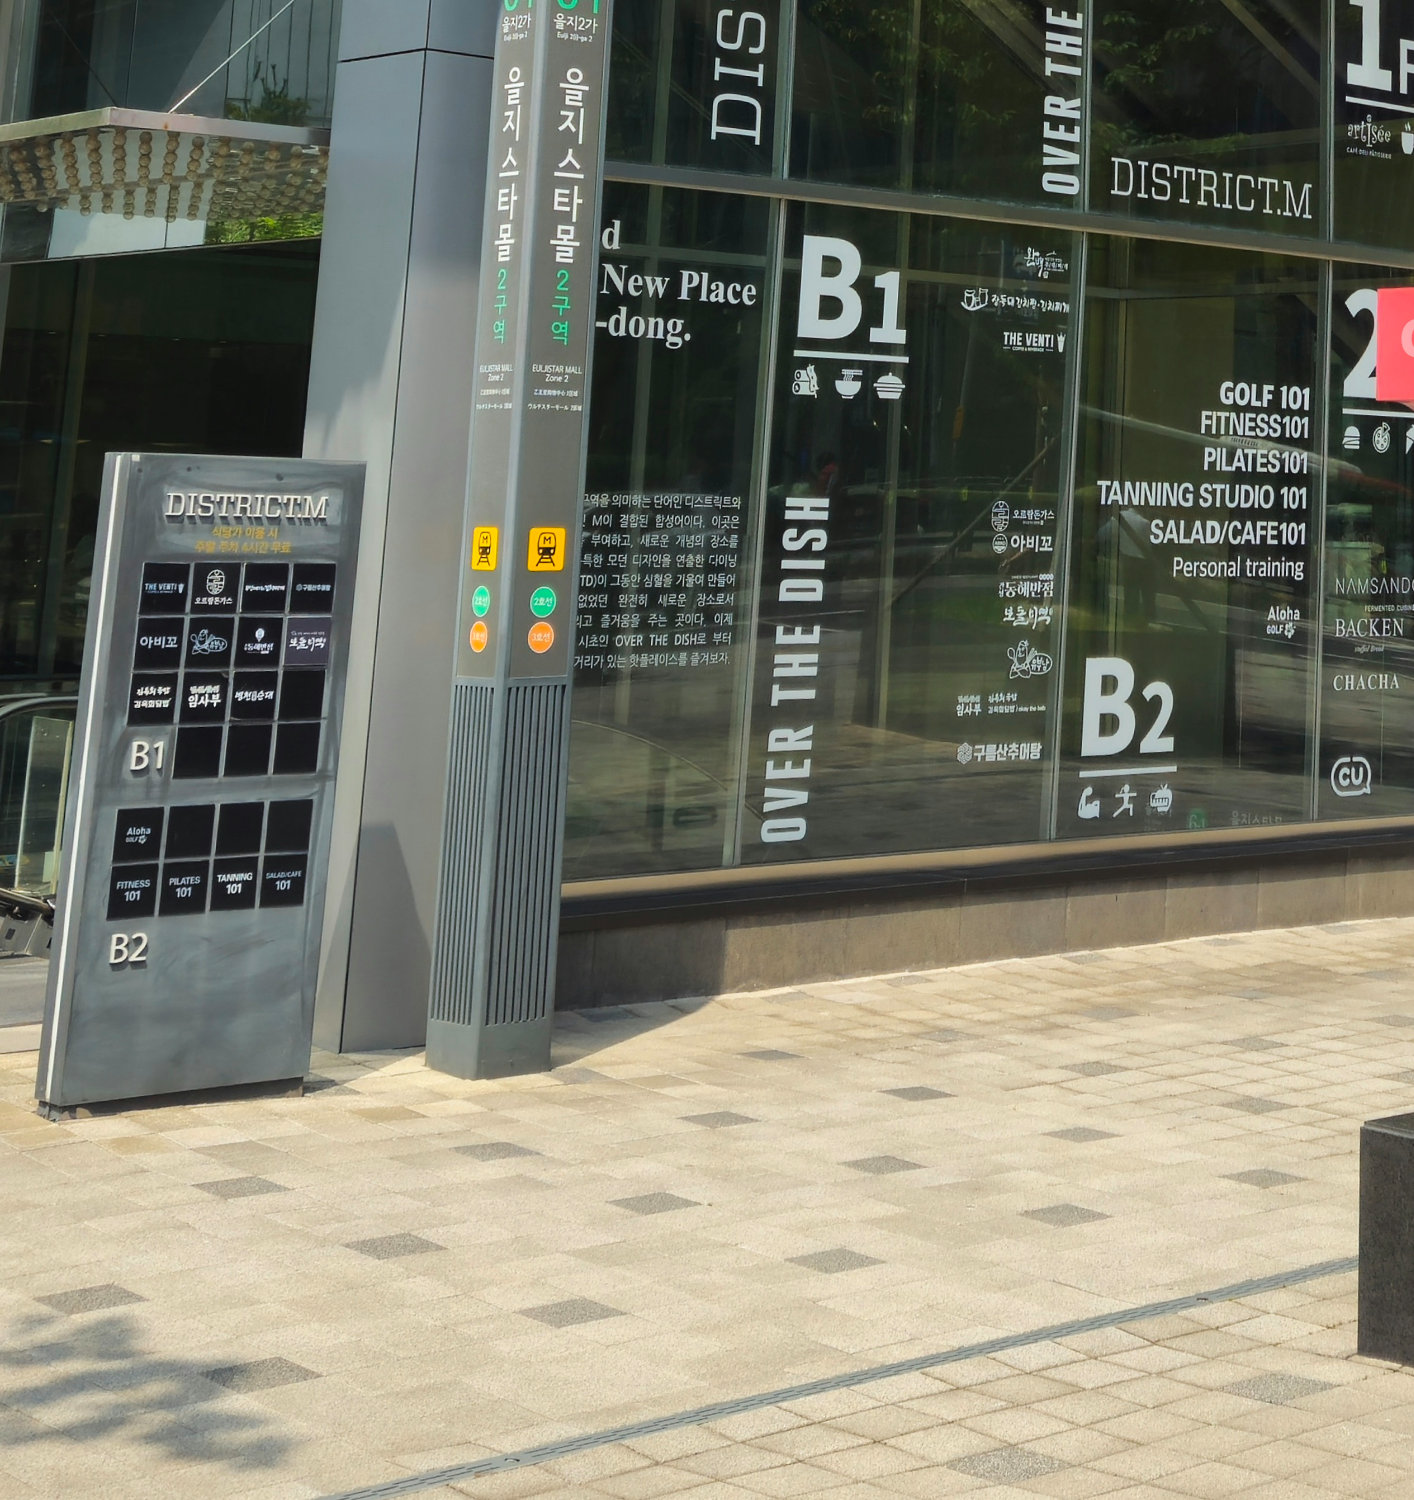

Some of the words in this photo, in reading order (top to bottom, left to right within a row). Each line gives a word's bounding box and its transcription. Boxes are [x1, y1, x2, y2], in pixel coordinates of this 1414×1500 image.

[502, 12, 531, 33] 을지2가
[554, 13, 598, 34] 을지2가
[1046, 6, 1083, 76] THE
[1347, 114, 1391, 147] artisée
[1042, 95, 1081, 194] OVER
[495, 67, 524, 262] 을지스타몰
[550, 67, 589, 263] 을지스타몰
[1111, 156, 1312, 219] DISTRICT.M
[601, 263, 670, 299] New
[677, 270, 757, 306] Place
[798, 234, 907, 345] B1
[493, 269, 508, 344] 2구역
[551, 269, 571, 345] 2구역
[595, 306, 691, 349] -dong.
[1003, 332, 1022, 345] THE
[1026, 333, 1054, 348] VENTI
[501, 364, 513, 372] MALL
[532, 364, 564, 373] EULJISTAR
[565, 365, 582, 374] MALL
[545, 374, 563, 382] Zone
[1220, 381, 1274, 407] GOLF
[1280, 385, 1310, 411] 101
[612, 494, 651, 508] 의미하는
[654, 495, 682, 509] 단어인
[685, 496, 741, 510] 디스트릭트와
[1097, 480, 1193, 507] TANNING
[1199, 483, 1275, 509] STUDIO
[1280, 487, 1307, 509] 101
[165, 493, 328, 519] DISTRICT.M
[592, 514, 613, 528] M이
[619, 514, 649, 528] 결합된
[655, 514, 706, 529] 합성어이다.
[711, 515, 740, 529] 이곳은
[591, 534, 634, 548] 부여하고,
[640, 534, 670, 548] 새로운
[675, 534, 704, 548] 개념의
[710, 534, 739, 549] 장소를
[778, 497, 830, 602] DISH
[1011, 535, 1053, 552] 아비꼬
[607, 554, 628, 568] 모던
[632, 554, 672, 568] 디자인을
[675, 554, 704, 568] 연출한
[708, 554, 737, 568] 다이닝
[1173, 556, 1241, 578] Personal
[1246, 557, 1304, 580] training
[610, 574, 641, 588] 그동안
[643, 574, 672, 588] 심혈을
[675, 574, 704, 587] 기울여
[707, 573, 736, 587] 만들어
[533, 597, 553, 606] 2호선
[578, 594, 608, 609] 없었던
[618, 594, 648, 608] 완전히
[657, 594, 687, 607] 새로운
[697, 593, 734, 606] 장소로서
[600, 614, 640, 628] 즐거움을
[648, 614, 667, 627] 주는
[675, 613, 706, 627] 곳이다.
[714, 612, 733, 626] 이제
[1267, 606, 1300, 620] Aloha
[1266, 625, 1284, 635] GOLF
[1335, 618, 1404, 637] BACKEN
[140, 636, 178, 649] 아비꼬
[531, 633, 551, 642] 3호선
[578, 634, 609, 648] 시초인
[615, 634, 643, 647] OVER
[650, 634, 668, 646] THE
[674, 633, 707, 646] DISH로
[712, 632, 732, 645] 부터
[607, 654, 626, 668] 있는
[629, 653, 687, 668] 핫플레이스를
[690, 652, 730, 667] 즐겨보자.
[771, 625, 821, 706] THE
[1333, 674, 1400, 691] CHACHA
[188, 694, 221, 708] 임사부
[1081, 657, 1174, 757] B2
[956, 703, 981, 716] 임사부
[130, 740, 164, 771] B1
[974, 742, 1042, 761] 구름산추어탕
[761, 724, 814, 843] OVER
[1339, 766, 1363, 787] CU
[126, 827, 151, 836] Aloha
[169, 876, 200, 886] PILATES
[217, 872, 253, 883] TANNING
[266, 870, 302, 879] SALAD/CAFE
[116, 879, 150, 890] FITNESS
[175, 887, 192, 898] 101
[226, 883, 242, 894] 101
[275, 880, 291, 890] 101
[124, 890, 141, 902] 101
[109, 932, 148, 964] B2
